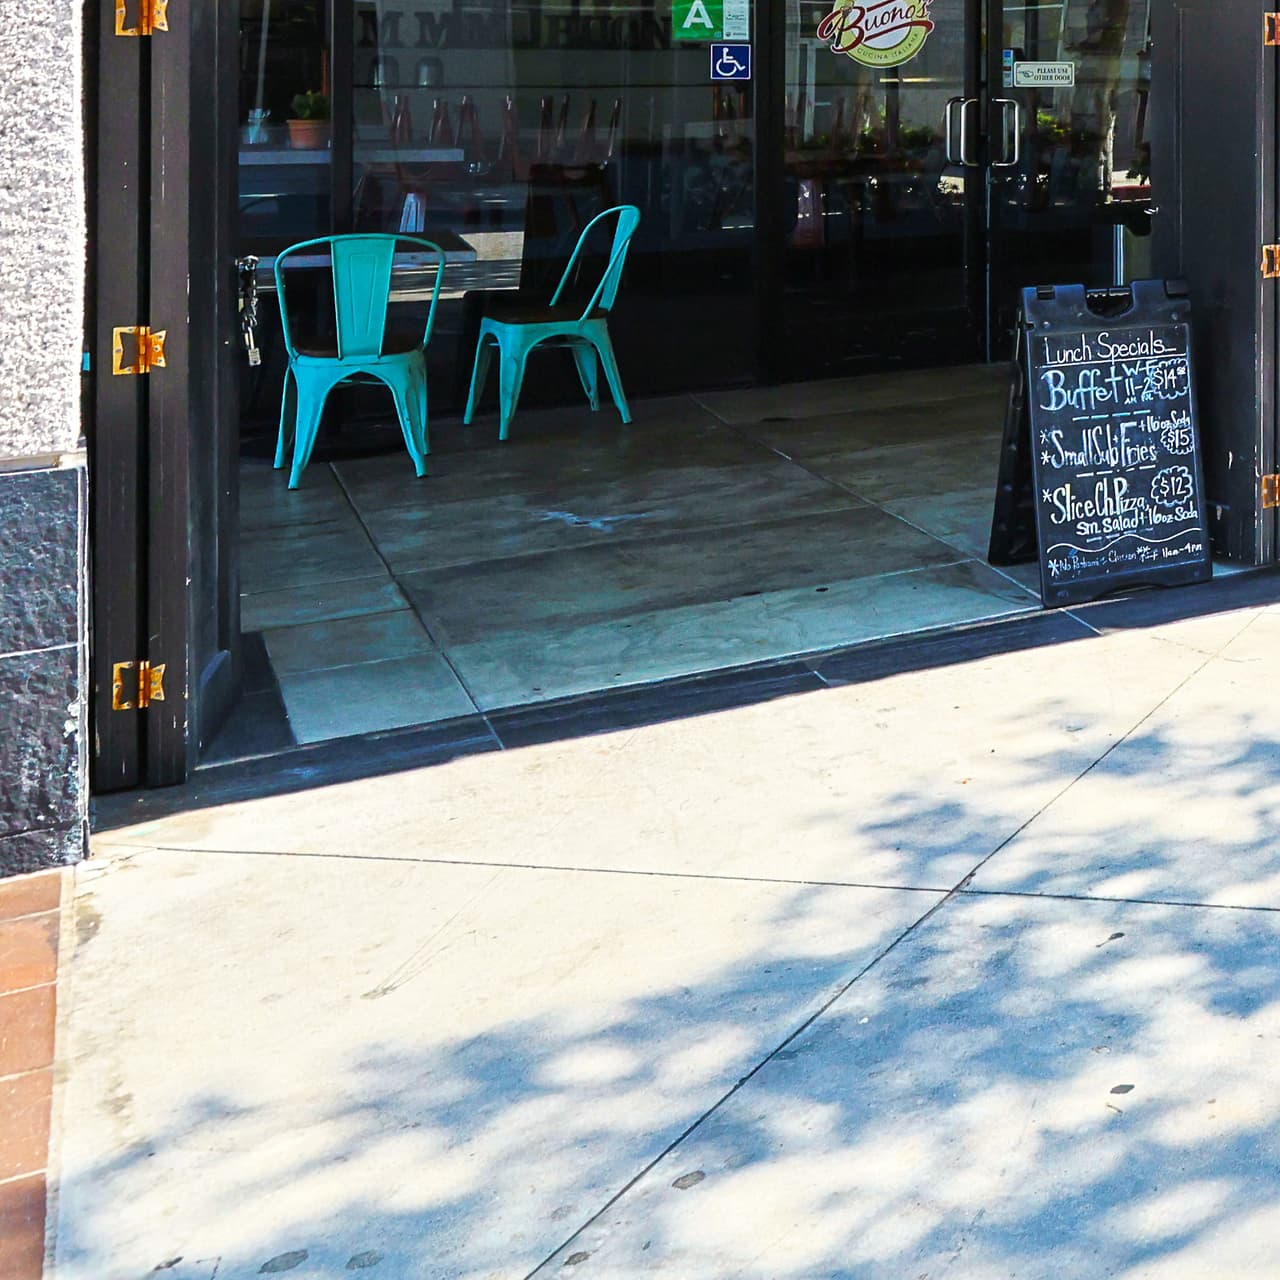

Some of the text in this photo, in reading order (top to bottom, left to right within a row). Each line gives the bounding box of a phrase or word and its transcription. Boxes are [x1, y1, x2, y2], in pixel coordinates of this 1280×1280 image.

[682, 0, 714, 29] A
[857, 32, 919, 60] CUCINA ITALIANA
[1045, 333, 1092, 364] Lunch
[1040, 366, 1123, 411] Buffet
[1119, 422, 1157, 467] Fries
[1167, 428, 1190, 448] $15
[1159, 476, 1187, 497] $12
